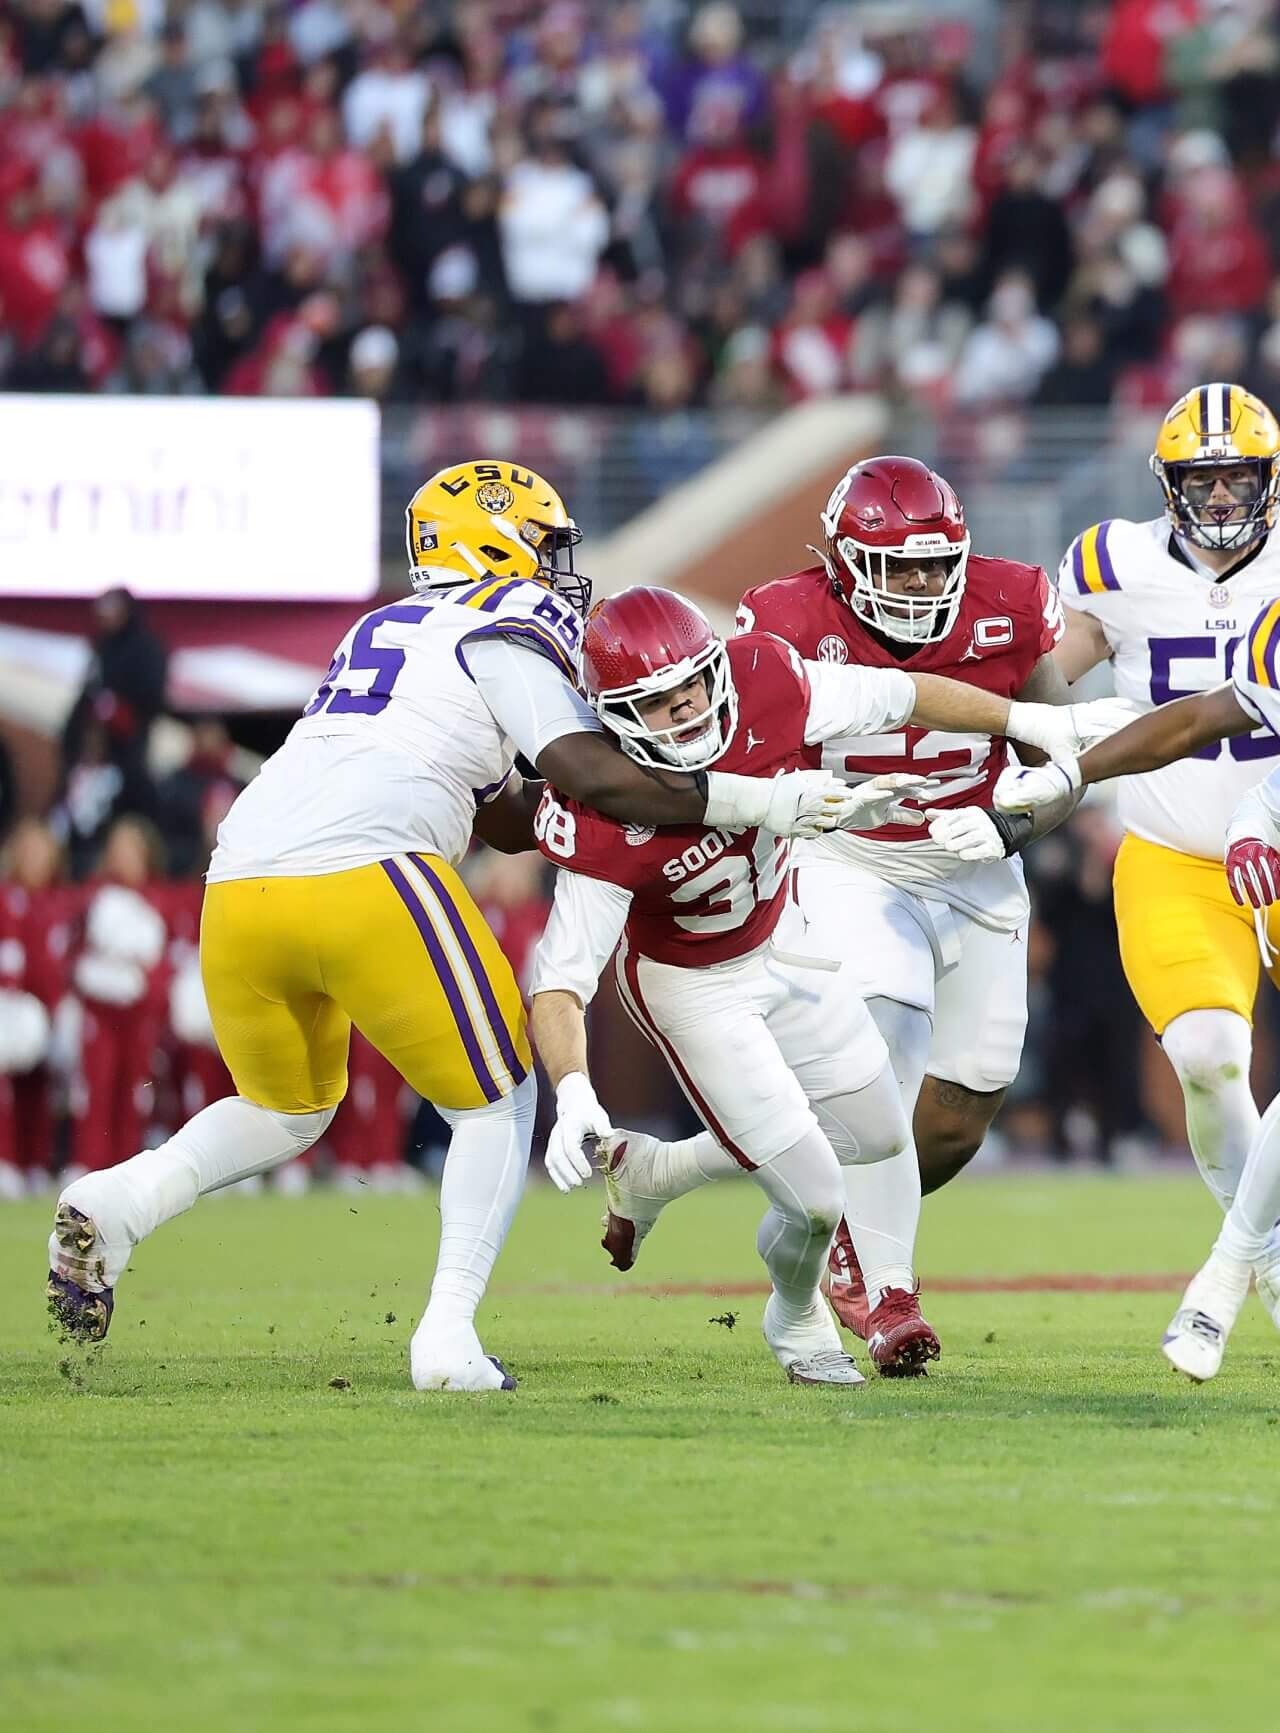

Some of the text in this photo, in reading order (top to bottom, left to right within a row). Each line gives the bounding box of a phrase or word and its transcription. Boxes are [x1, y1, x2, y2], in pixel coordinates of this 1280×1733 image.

[1204, 449, 1227, 457] LSU
[439, 465, 534, 497] LSU
[532, 594, 580, 650] 65
[976, 618, 1012, 646] C
[1205, 619, 1237, 631] LSU
[820, 639, 848, 664] SEC
[662, 825, 752, 883] SOON
